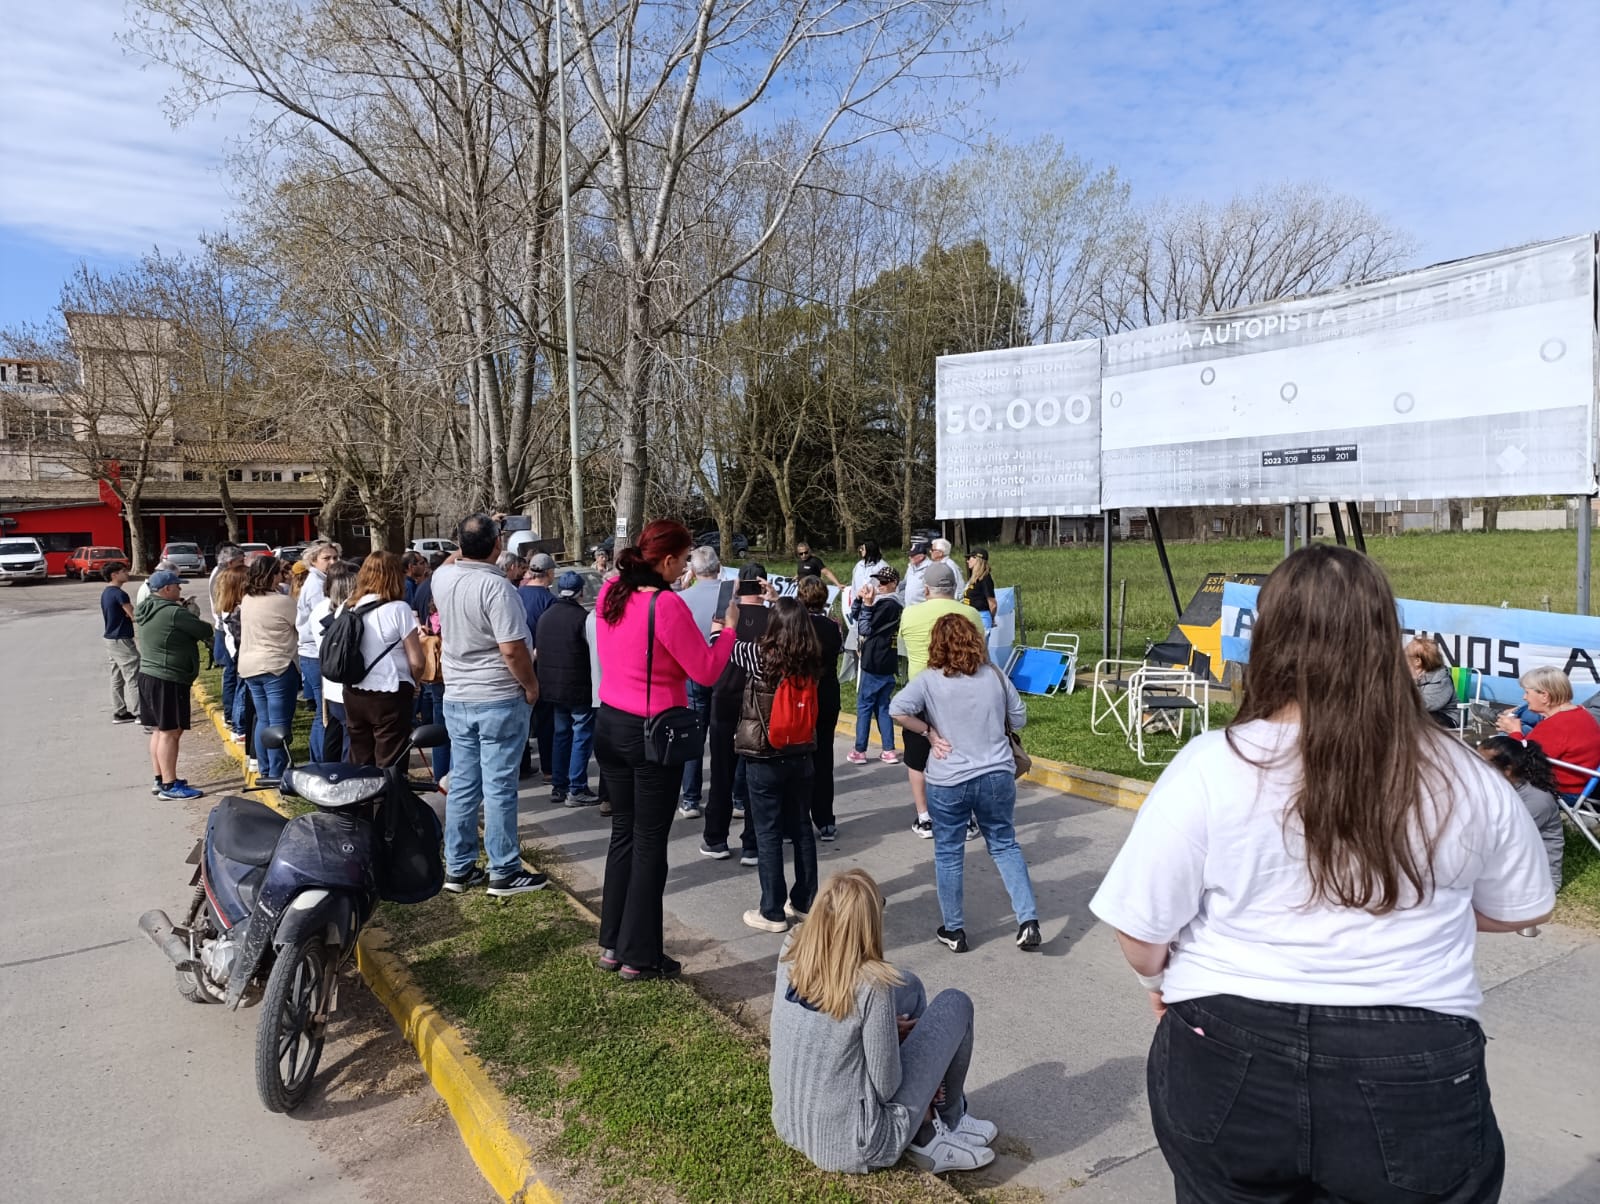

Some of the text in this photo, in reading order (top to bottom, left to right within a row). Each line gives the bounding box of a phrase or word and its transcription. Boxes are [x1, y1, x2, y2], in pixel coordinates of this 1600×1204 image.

[1200, 309, 1338, 347] AUTOPISTA
[946, 394, 1091, 434] 50.000
[1284, 456, 1299, 464] 309
[1311, 454, 1326, 462] 559
[1335, 452, 1349, 461] 201
[1263, 457, 1282, 465] 2022
